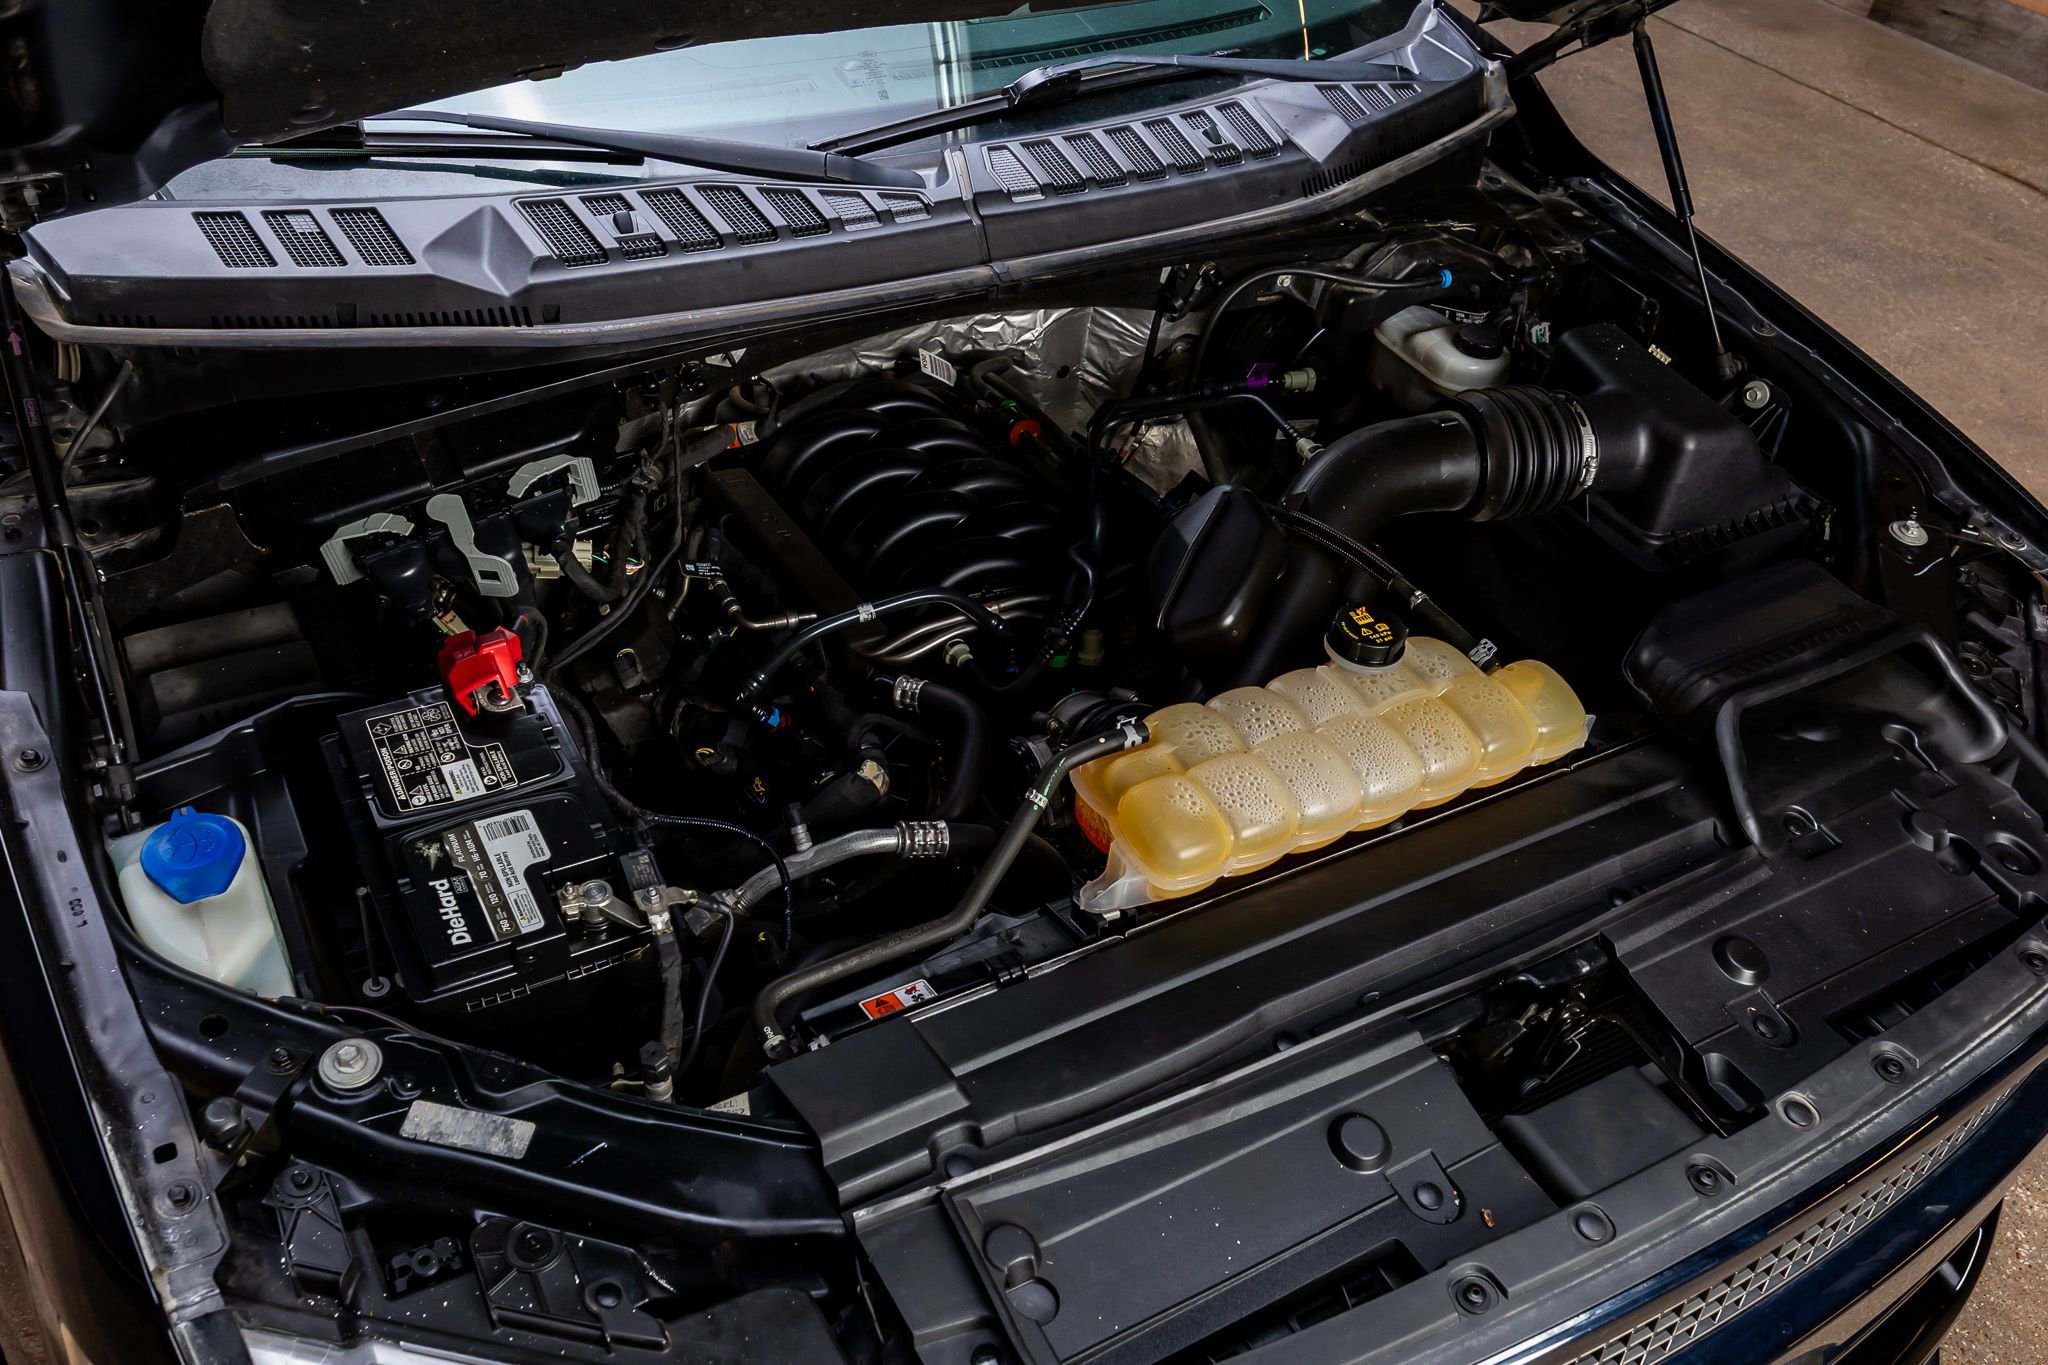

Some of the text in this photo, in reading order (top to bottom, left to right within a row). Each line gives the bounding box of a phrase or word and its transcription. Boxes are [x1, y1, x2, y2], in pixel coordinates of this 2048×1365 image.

[448, 833, 466, 862] PLATINUM
[502, 851, 512, 867] Battery
[479, 871, 488, 879] 70
[494, 853, 514, 888] NON-SPILLABLE
[512, 874, 520, 886] Lead
[488, 893, 499, 905] 120
[428, 879, 472, 946] DieHard
[500, 919, 511, 932] 760
[763, 1026, 775, 1038] RAD
